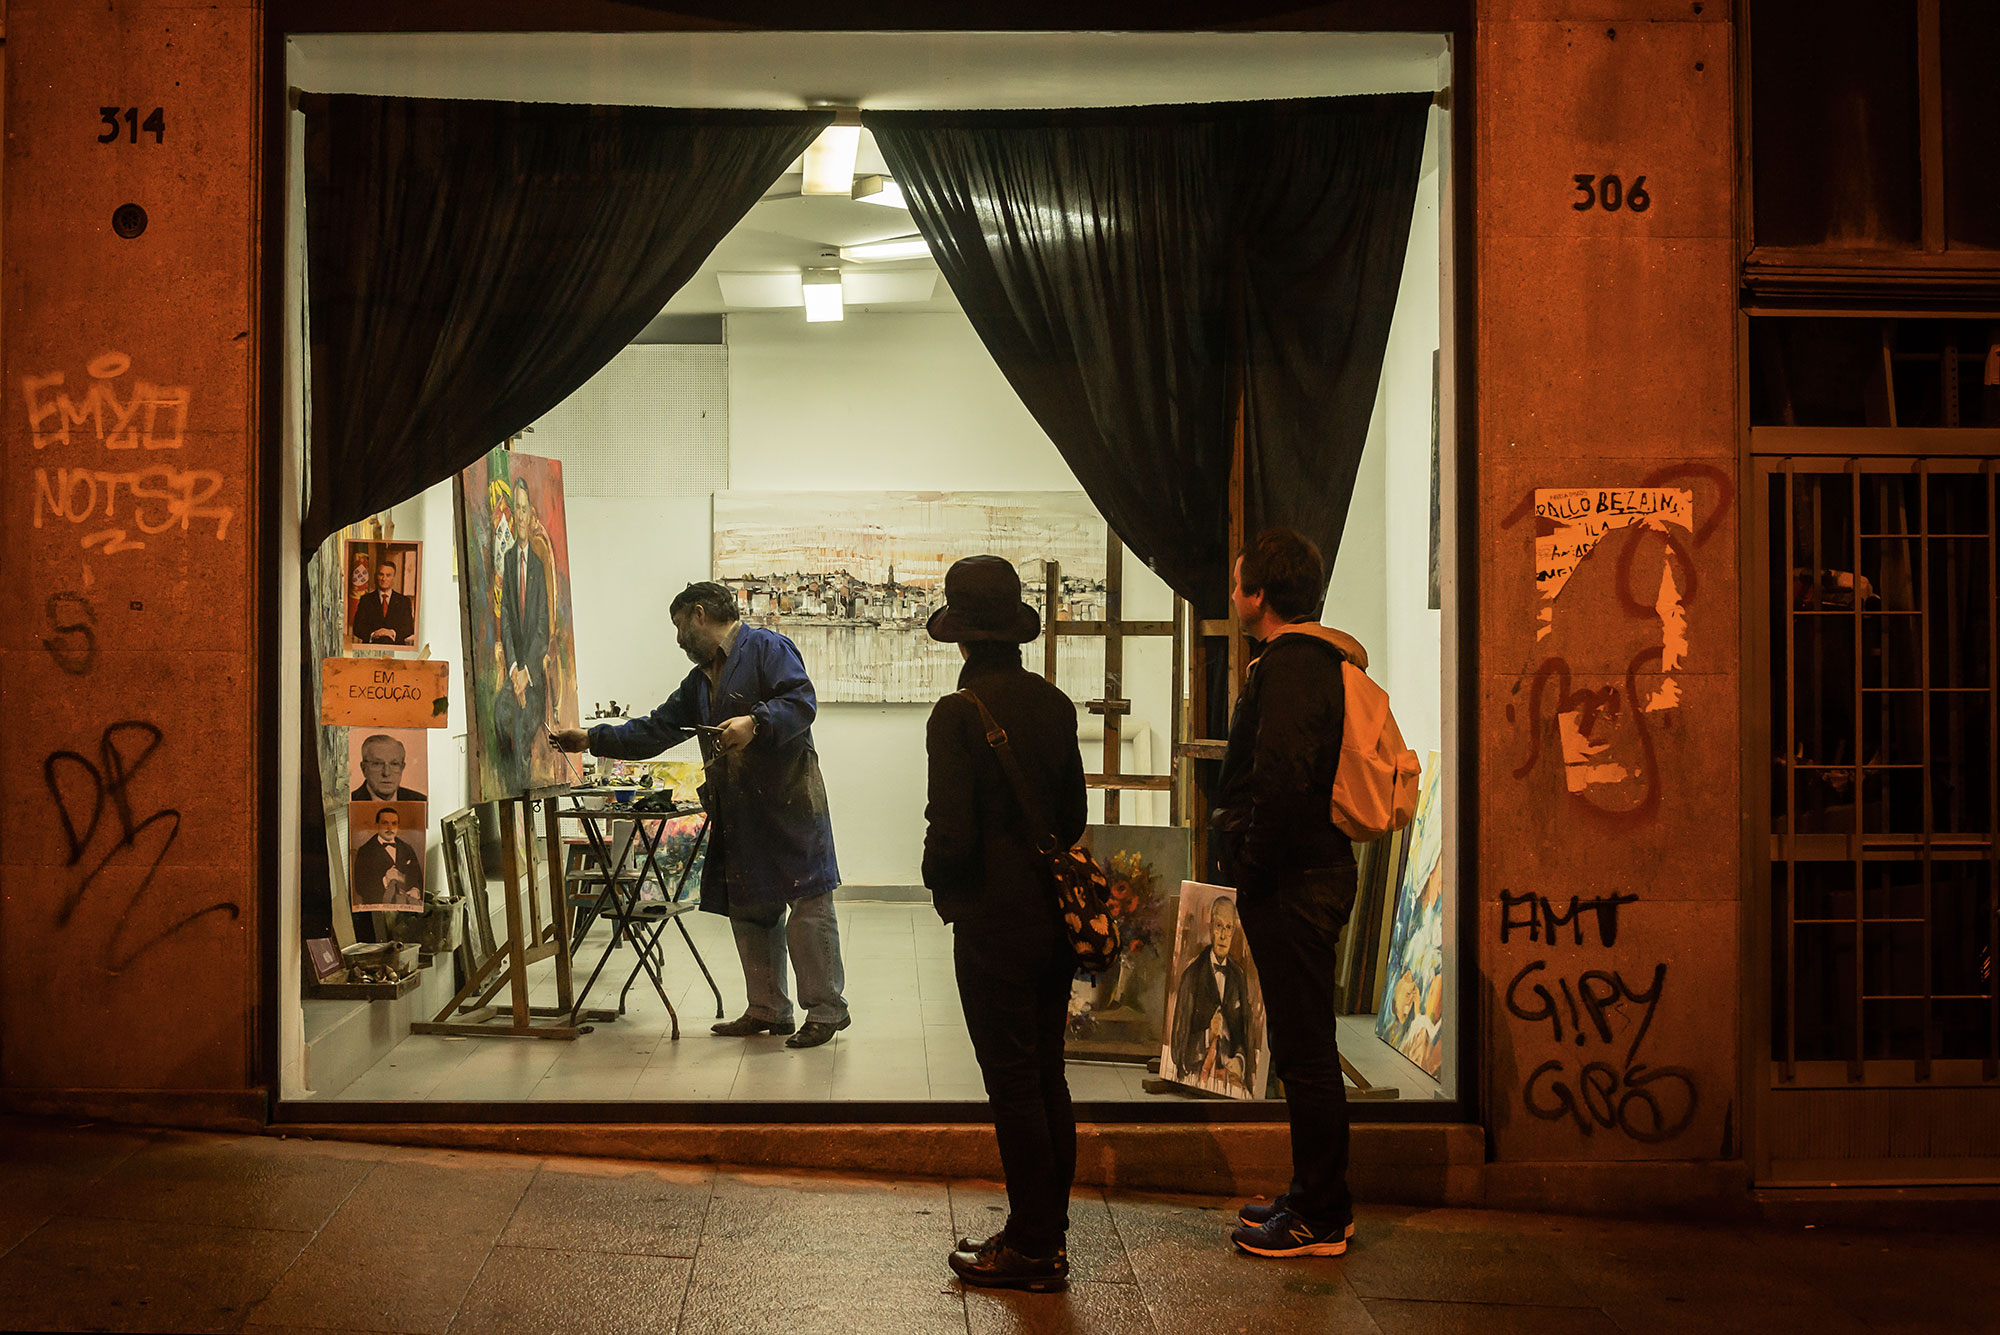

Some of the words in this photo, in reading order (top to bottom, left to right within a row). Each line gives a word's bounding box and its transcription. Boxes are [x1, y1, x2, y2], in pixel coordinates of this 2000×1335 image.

[97, 106, 165, 144] 314
[1573, 174, 1651, 212] 306
[373, 670, 395, 683] EM
[349, 684, 422, 702] EXECUÇÃO
